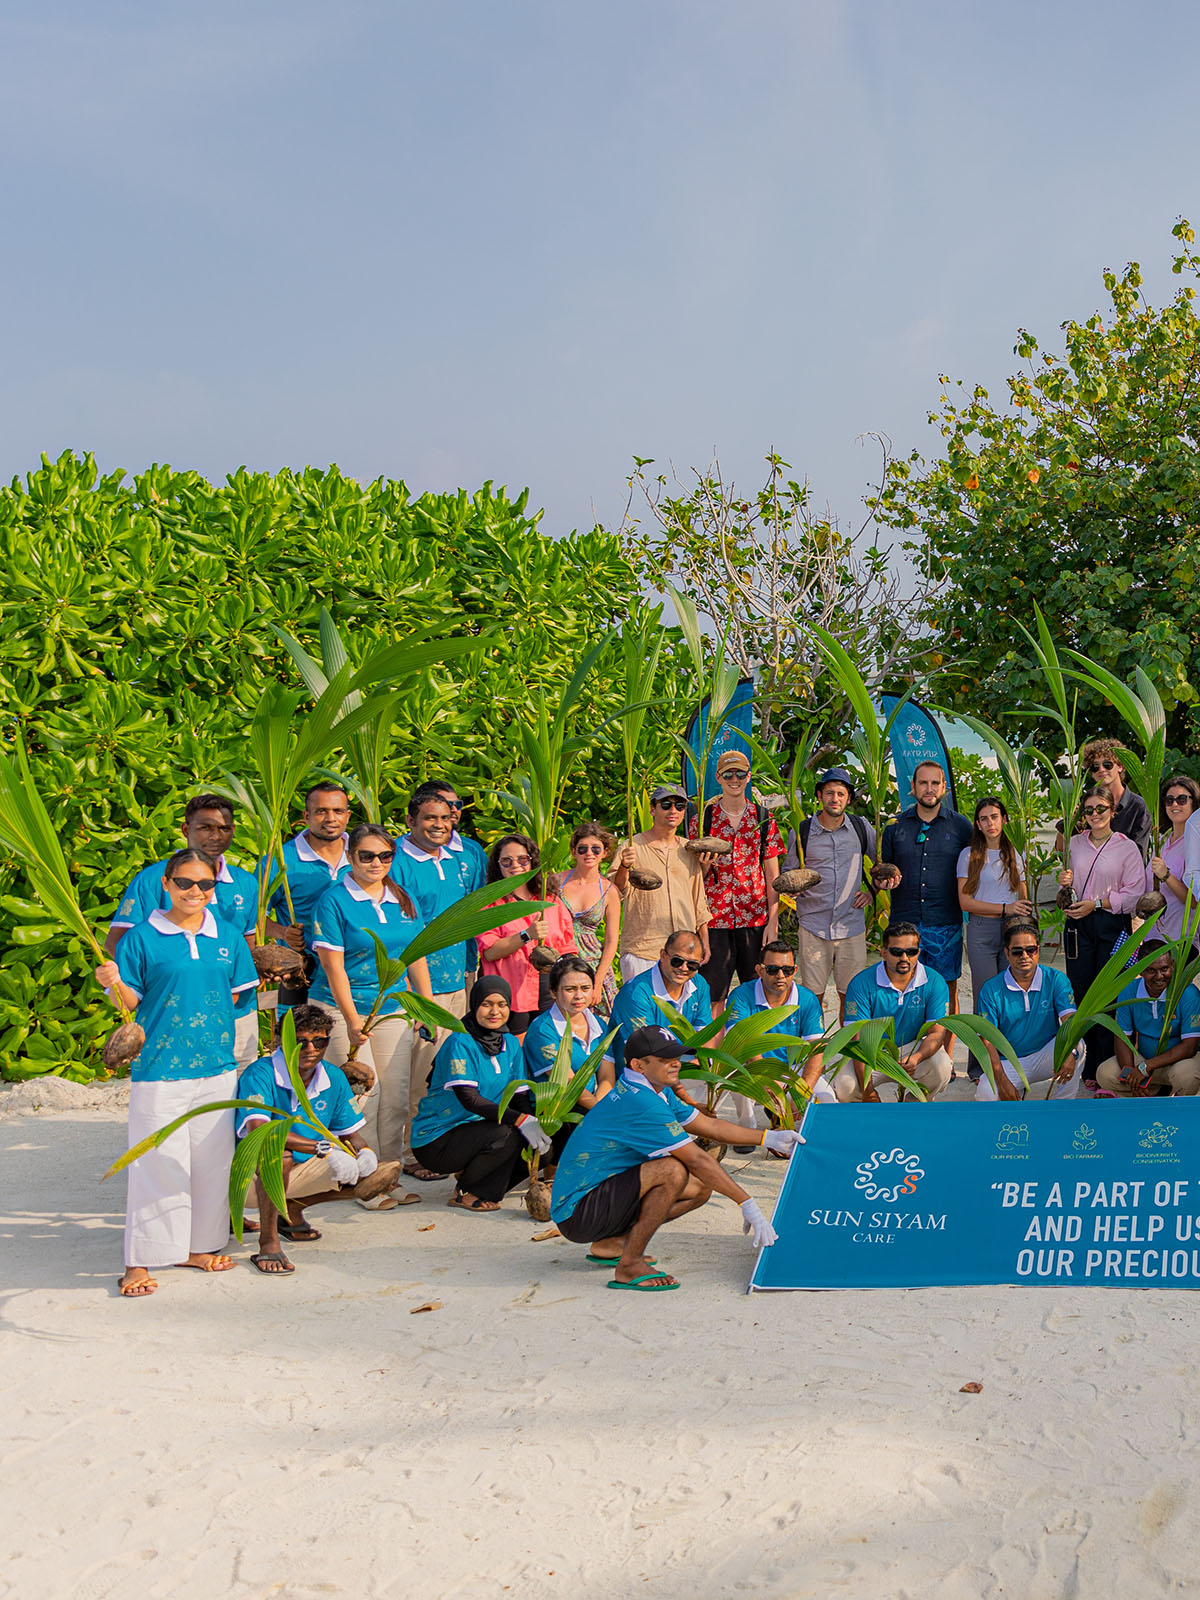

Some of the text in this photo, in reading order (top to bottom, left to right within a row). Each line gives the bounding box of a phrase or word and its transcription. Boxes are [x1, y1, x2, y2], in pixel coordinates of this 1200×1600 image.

[1045, 1182, 1063, 1208] A
[1073, 1181, 1145, 1208] PART
[1154, 1180, 1189, 1207] OF
[807, 1209, 948, 1230] SUN SIYAM
[1023, 1215, 1083, 1242] AND
[1093, 1215, 1165, 1242] HELP
[852, 1232, 896, 1244] CARE
[1015, 1249, 1075, 1277] OUR
